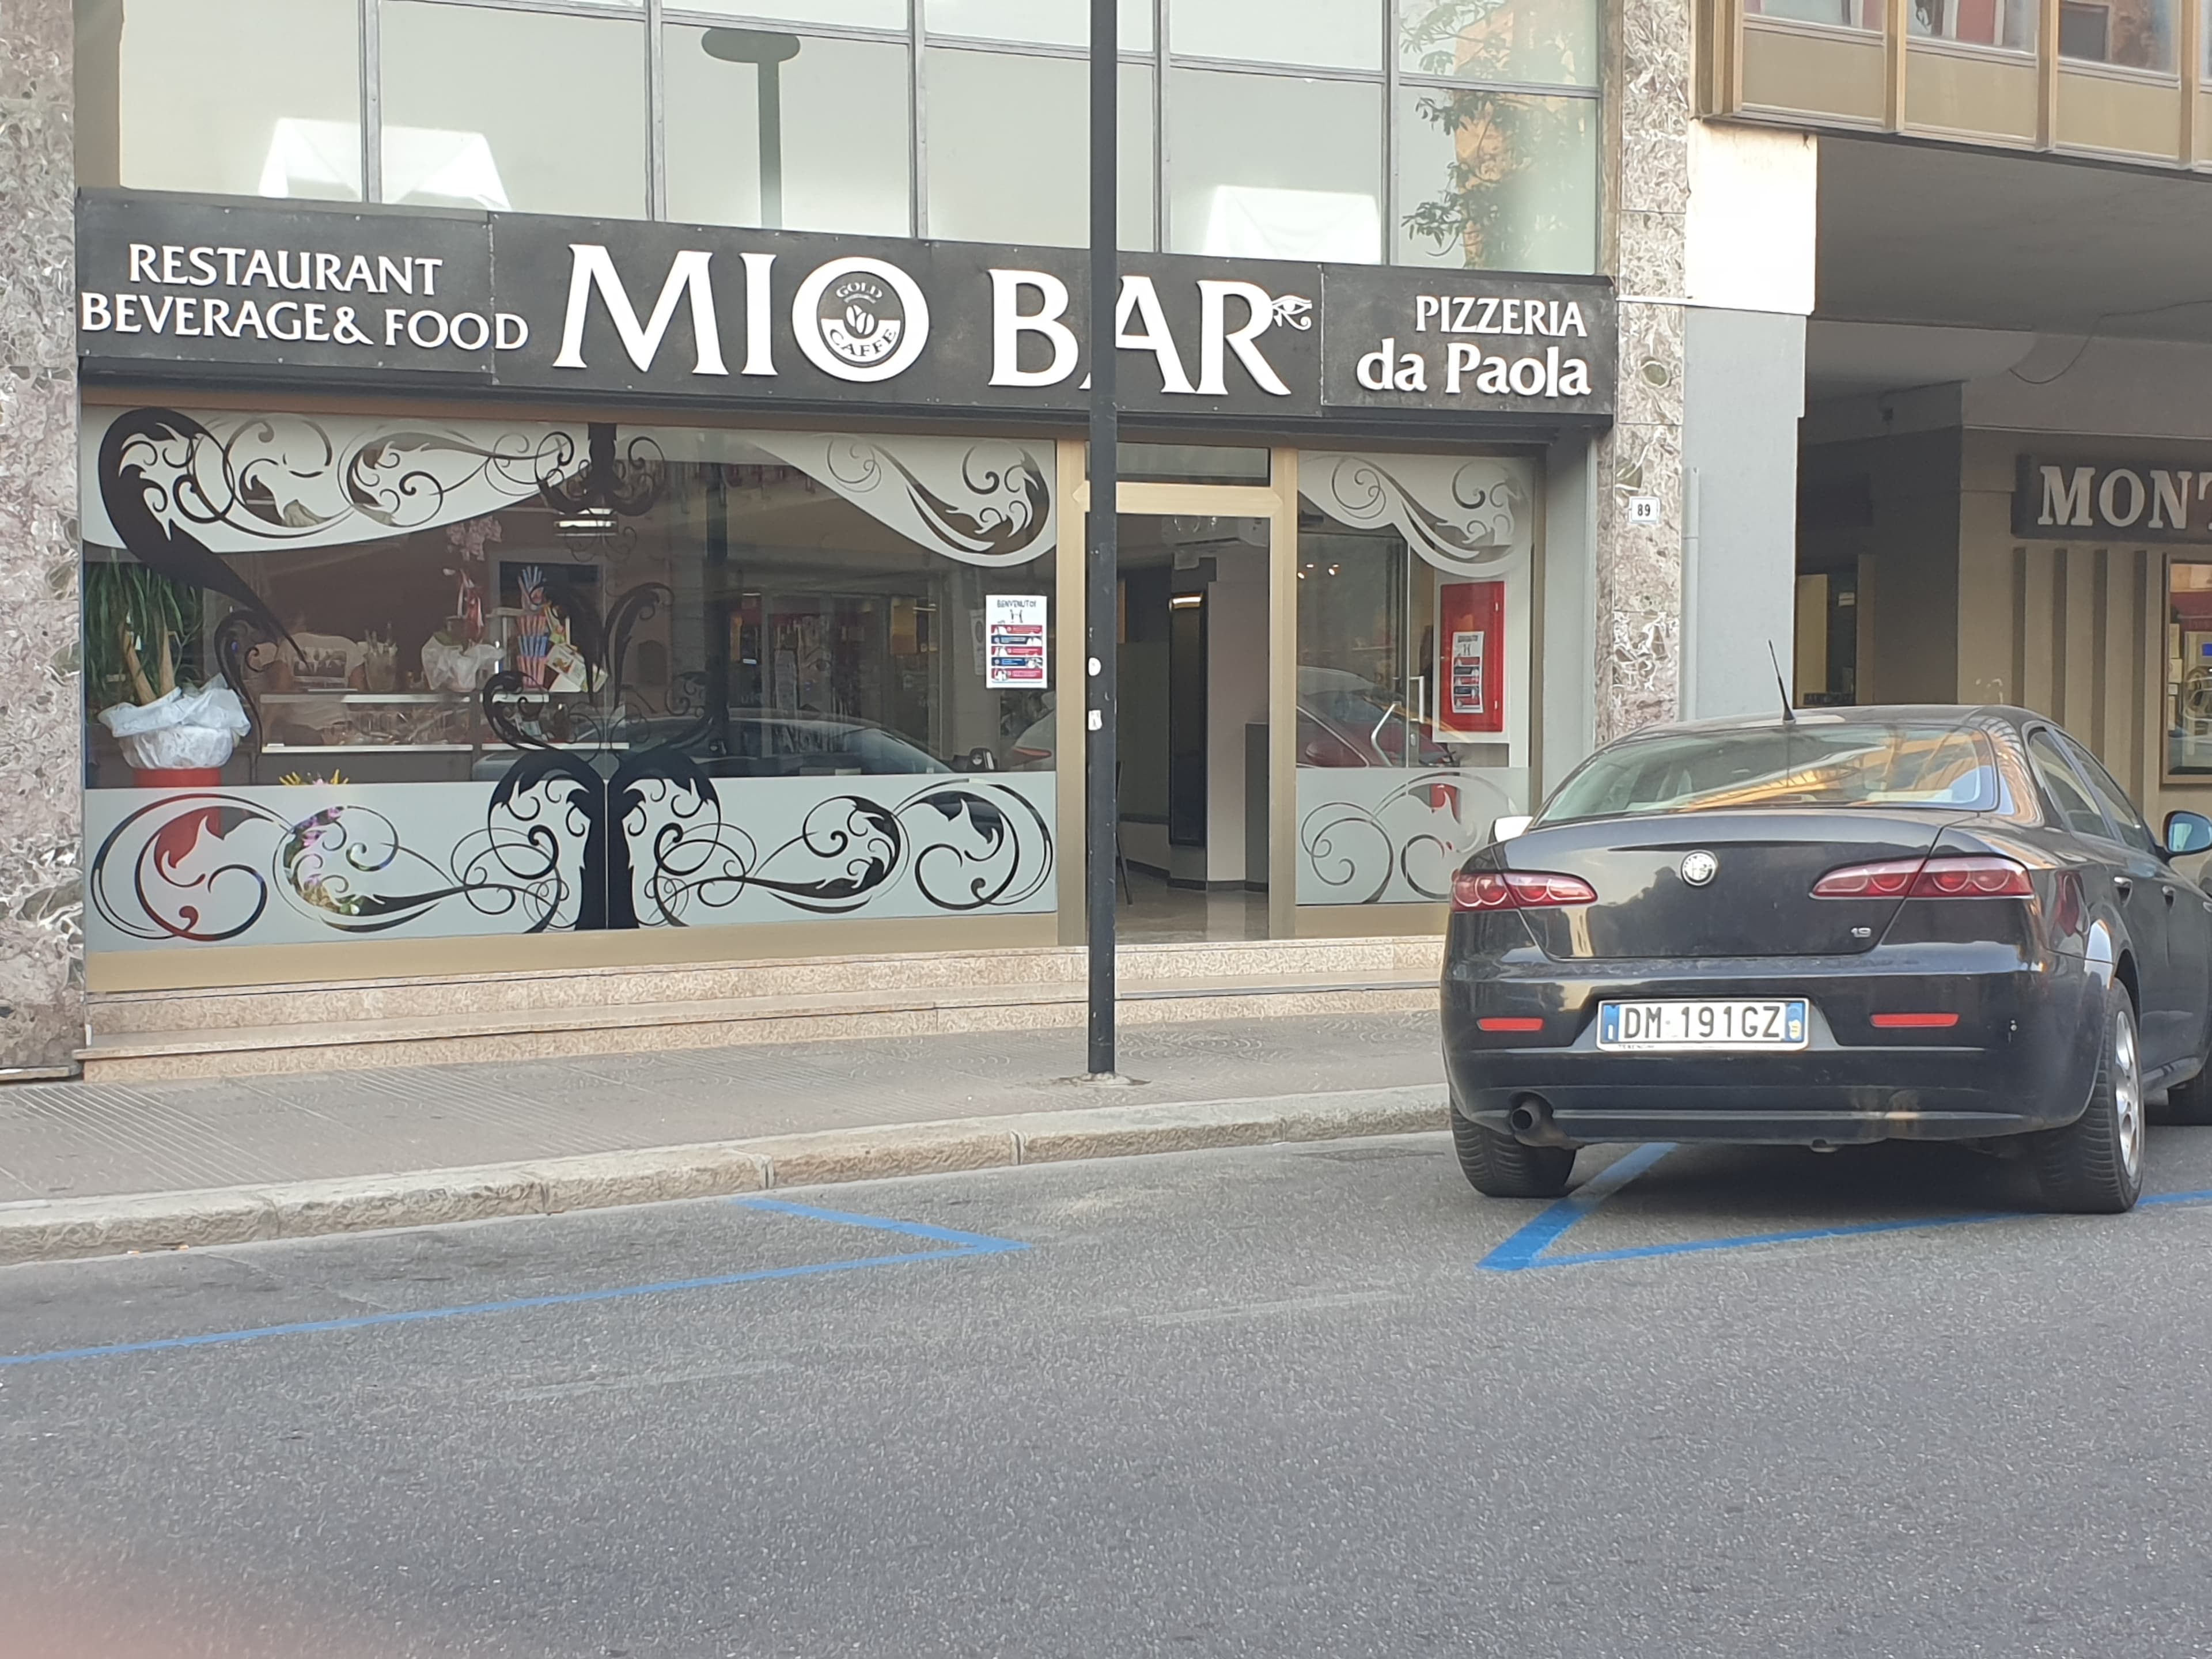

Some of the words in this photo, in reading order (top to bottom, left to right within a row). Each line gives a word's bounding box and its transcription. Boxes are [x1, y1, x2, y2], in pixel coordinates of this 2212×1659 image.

[130, 244, 443, 296] RESTAURANT
[836, 282, 882, 298] GOLD
[81, 292, 374, 345] BEVERAGE&
[385, 309, 529, 350] FOOD
[552, 244, 930, 382] MIO
[988, 268, 1292, 396] BAR
[1415, 295, 1588, 337] PIZZERIA
[830, 329, 897, 357] CAFFE
[1356, 338, 1427, 392] da
[1445, 342, 1592, 397] Paola
[1637, 503, 1651, 517] 89
[2037, 466, 2212, 529] MON
[1624, 1007, 1662, 1039] DM
